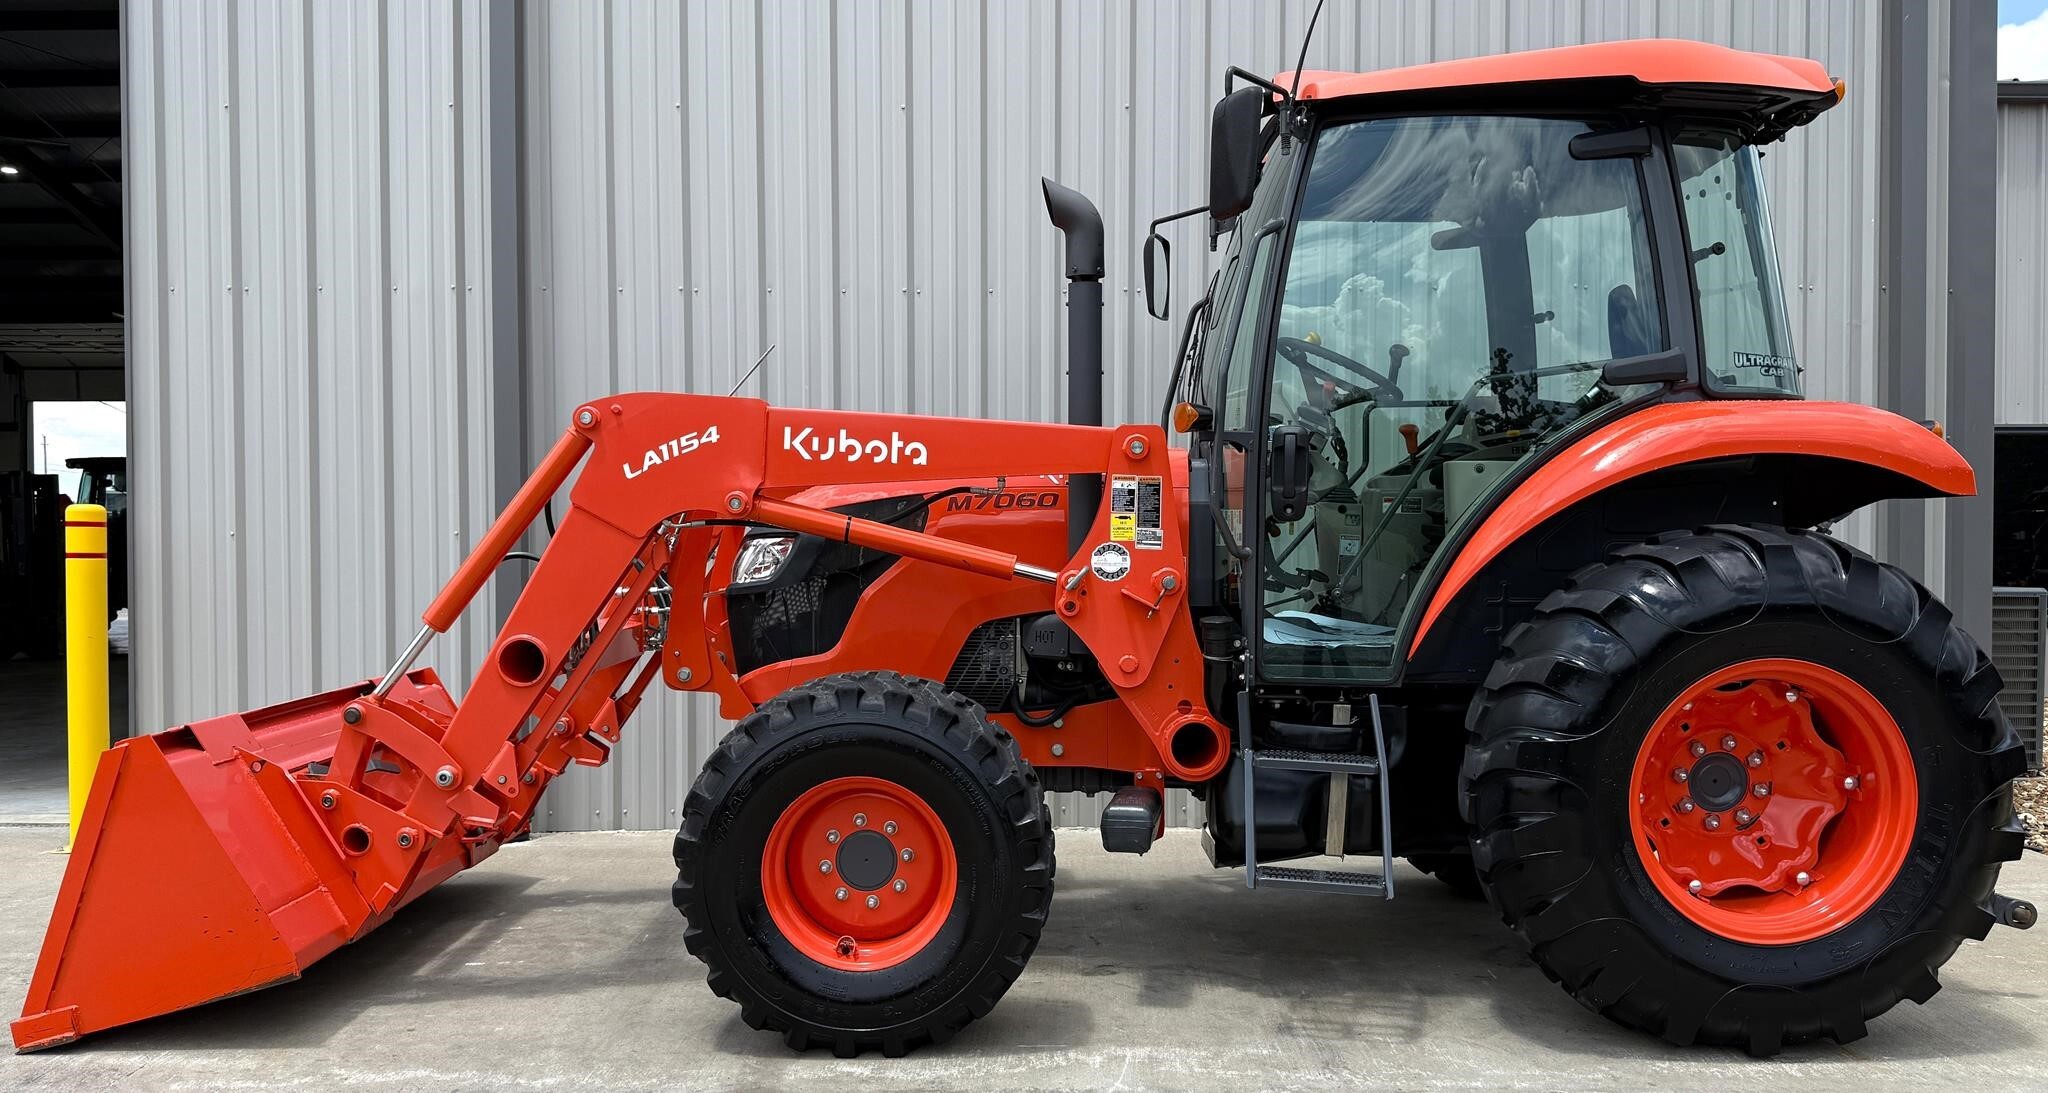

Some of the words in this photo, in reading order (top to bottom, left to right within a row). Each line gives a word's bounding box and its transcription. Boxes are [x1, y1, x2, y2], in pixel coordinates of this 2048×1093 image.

[1734, 352, 1792, 368] ULTRAGRA
[1760, 366, 1784, 377] CAB
[622, 425, 720, 480] LA1154
[783, 426, 928, 466] Kubota
[946, 492, 1060, 512] M7060
[1035, 630, 1055, 644] HOT
